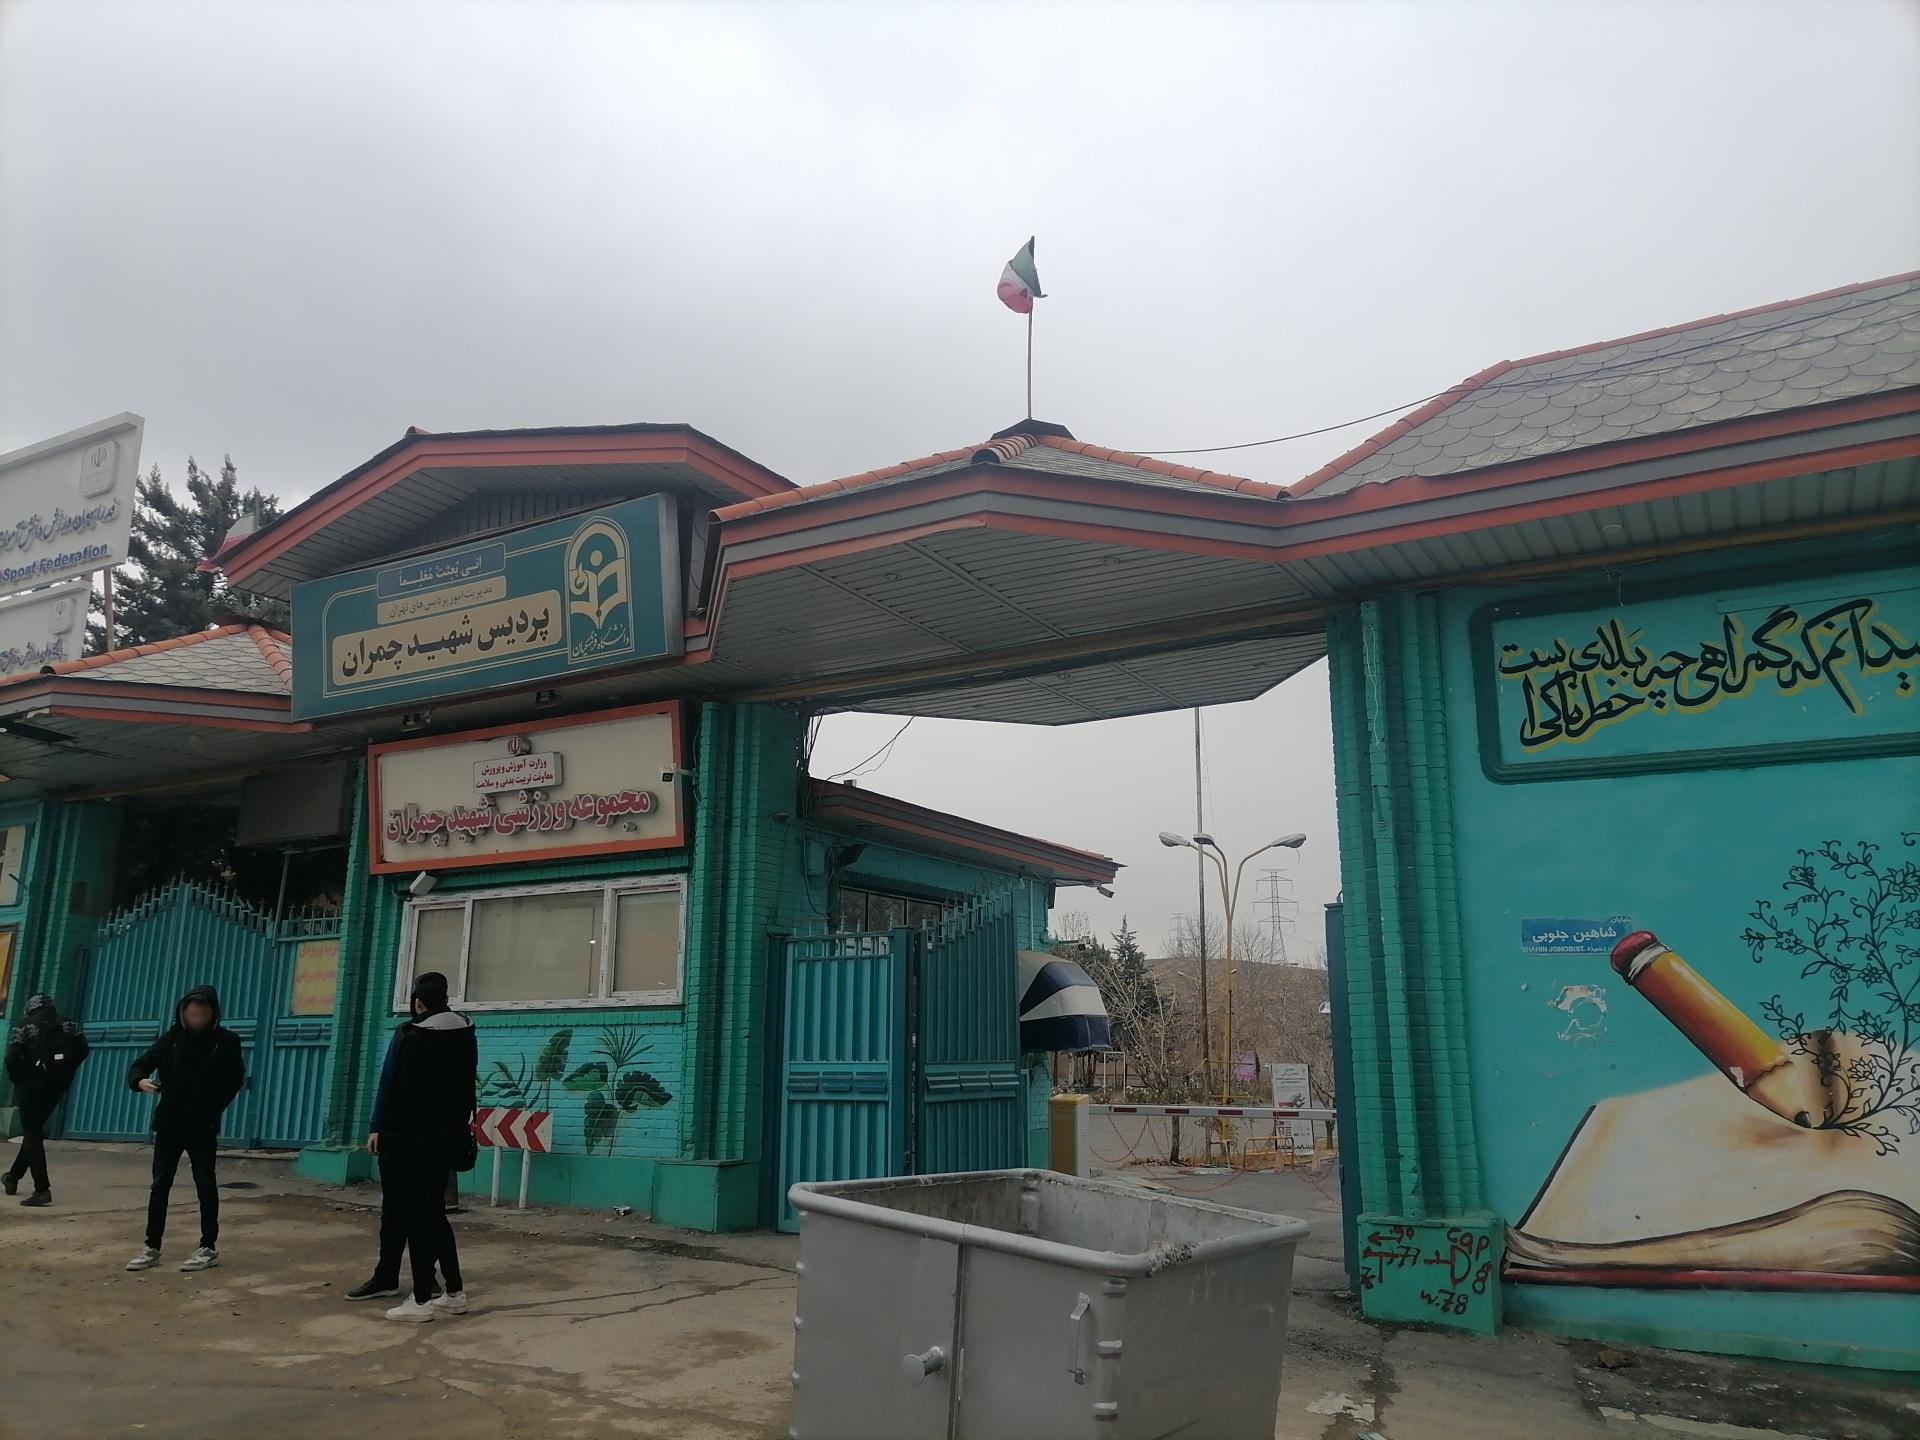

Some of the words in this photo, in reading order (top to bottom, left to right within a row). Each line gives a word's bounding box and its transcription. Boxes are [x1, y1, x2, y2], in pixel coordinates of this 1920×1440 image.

[3, 562, 36, 581] Sport
[40, 544, 107, 571] Federation
[477, 606, 550, 651] پردیس
[407, 614, 474, 662] شهید
[342, 636, 403, 677] چمران
[481, 764, 502, 776] پرورش
[505, 759, 527, 773] آموزش
[529, 757, 547, 769] وزارت
[475, 779, 495, 789] سلامت
[500, 776, 515, 788] بدنی
[515, 773, 532, 785] تربیت
[533, 771, 553, 783] معاونت
[494, 790, 568, 836] ورزشی
[569, 788, 650, 831] مجموعه
[386, 804, 445, 846] چمران
[447, 795, 492, 842] شهید
[1532, 929, 1569, 943] جنوبی
[1573, 926, 1617, 943] شاهین
